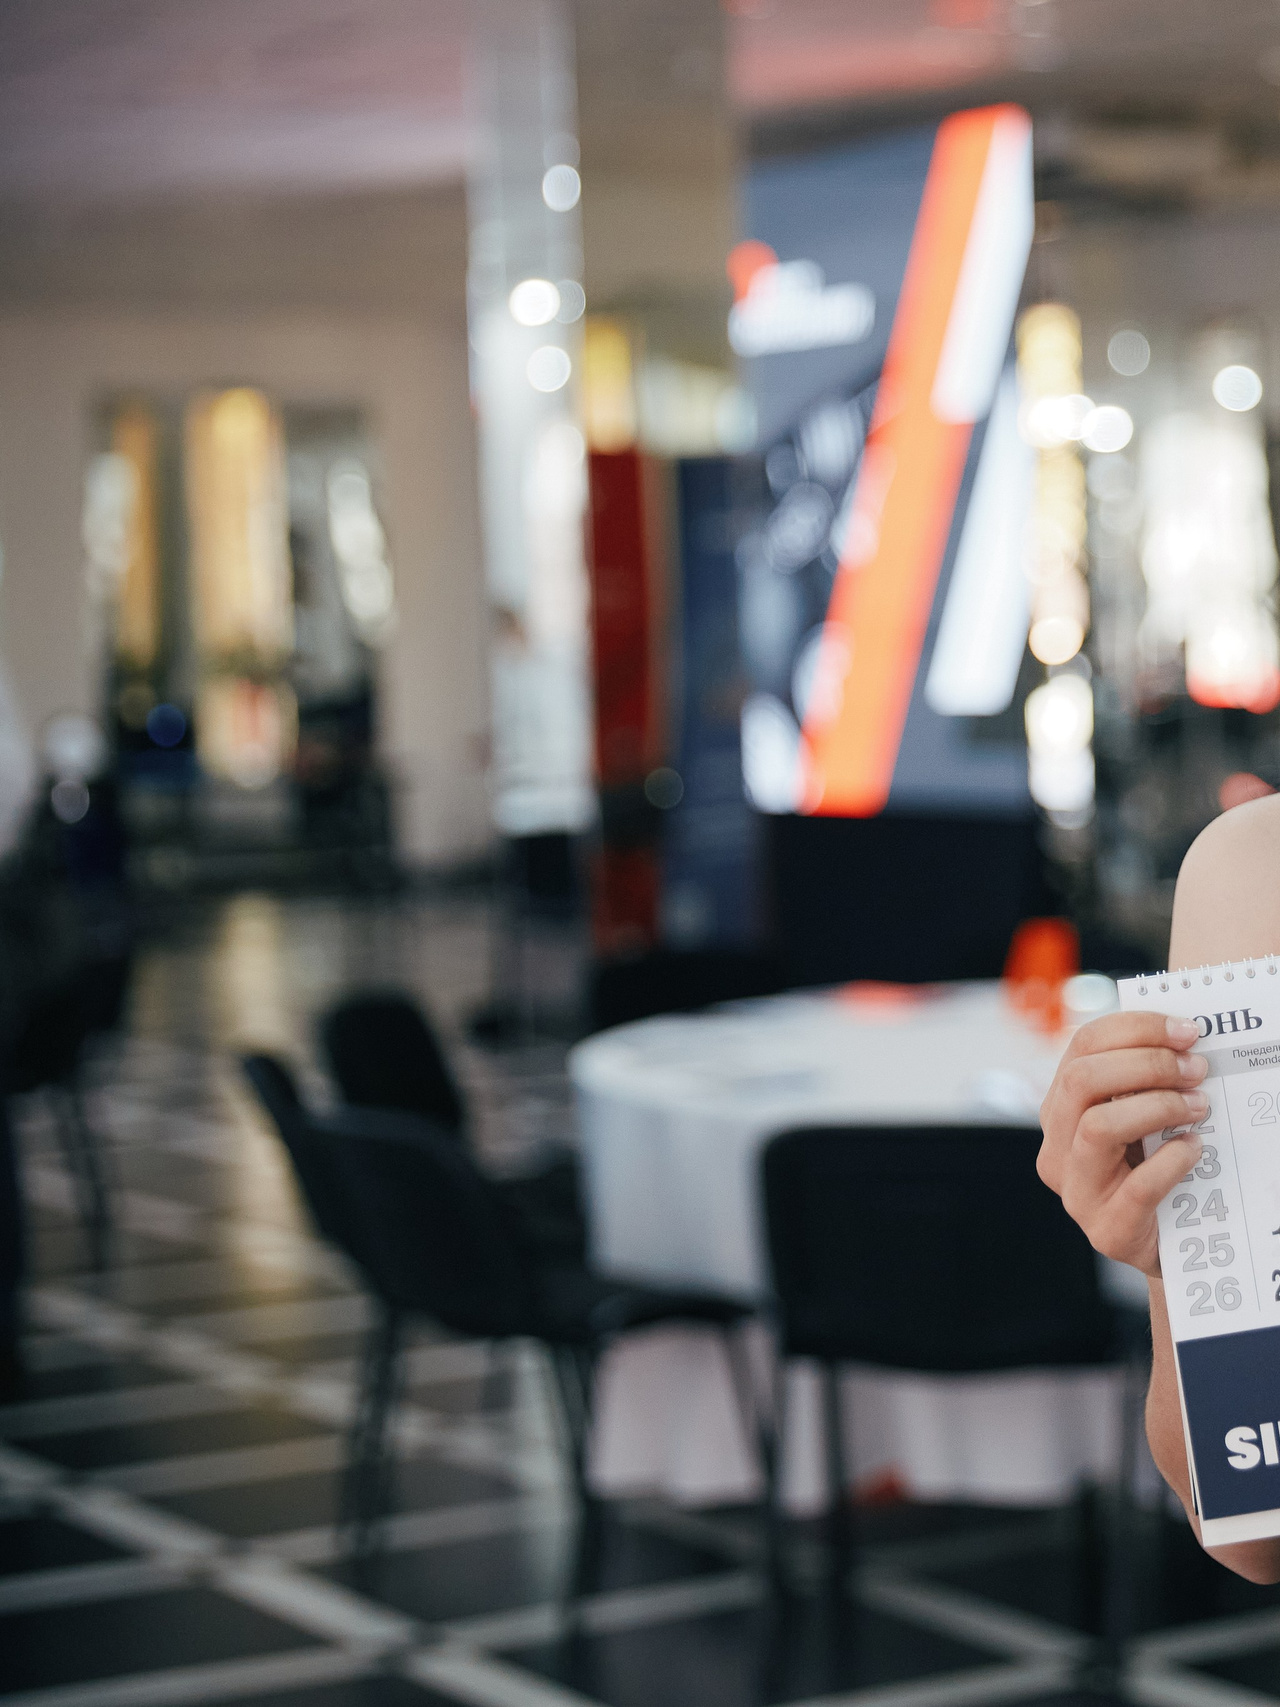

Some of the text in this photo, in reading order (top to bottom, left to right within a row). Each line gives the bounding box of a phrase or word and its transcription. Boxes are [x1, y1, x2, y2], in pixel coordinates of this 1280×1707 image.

[1180, 1145, 1222, 1183] 3
[1172, 1189, 1230, 1229] 24
[1179, 1233, 1236, 1273] 25
[1185, 1277, 1242, 1317] 26
